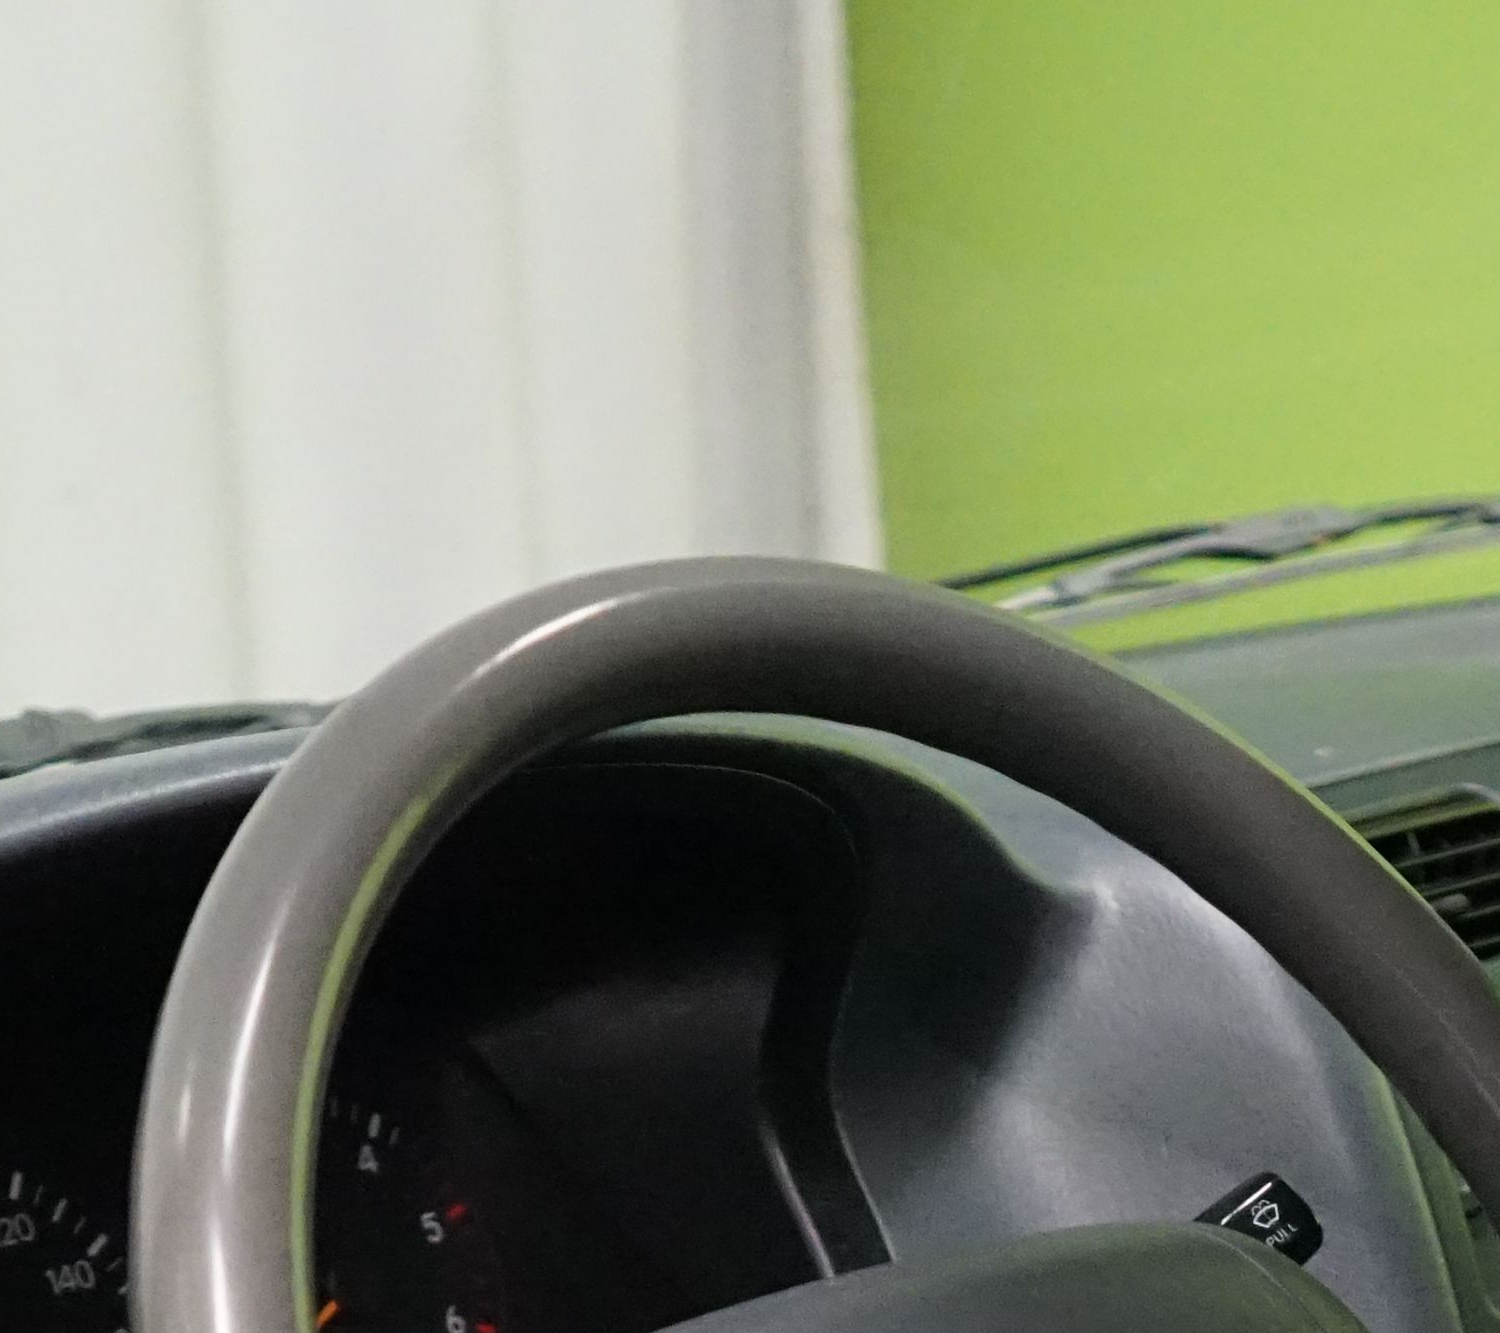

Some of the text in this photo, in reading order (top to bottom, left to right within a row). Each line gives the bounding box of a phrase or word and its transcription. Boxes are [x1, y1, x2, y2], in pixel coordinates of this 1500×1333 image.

[420, 1211, 444, 1244] 5
[1265, 1223, 1298, 1248] PULL
[45, 1260, 96, 1296] 140
